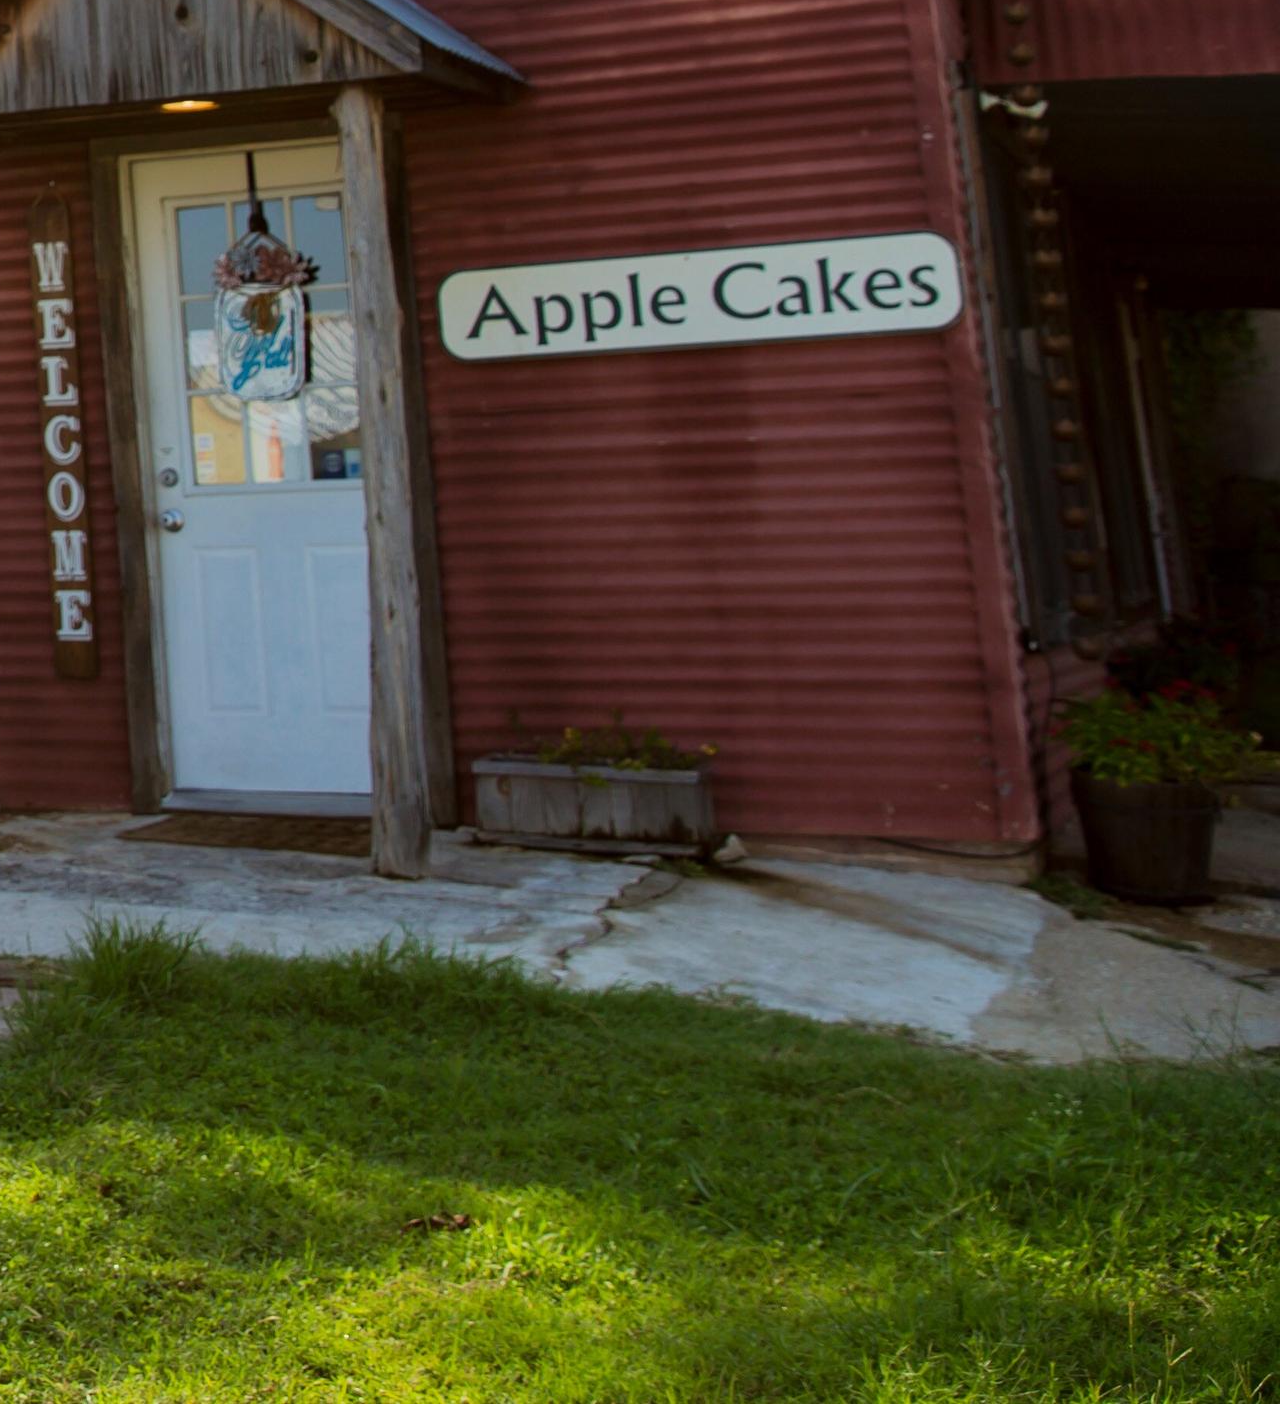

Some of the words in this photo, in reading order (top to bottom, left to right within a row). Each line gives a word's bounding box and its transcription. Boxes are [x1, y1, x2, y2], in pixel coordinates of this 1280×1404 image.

[466, 273, 687, 346] Apple
[712, 258, 940, 321] Cakes
[32, 241, 92, 642] WELCOME
